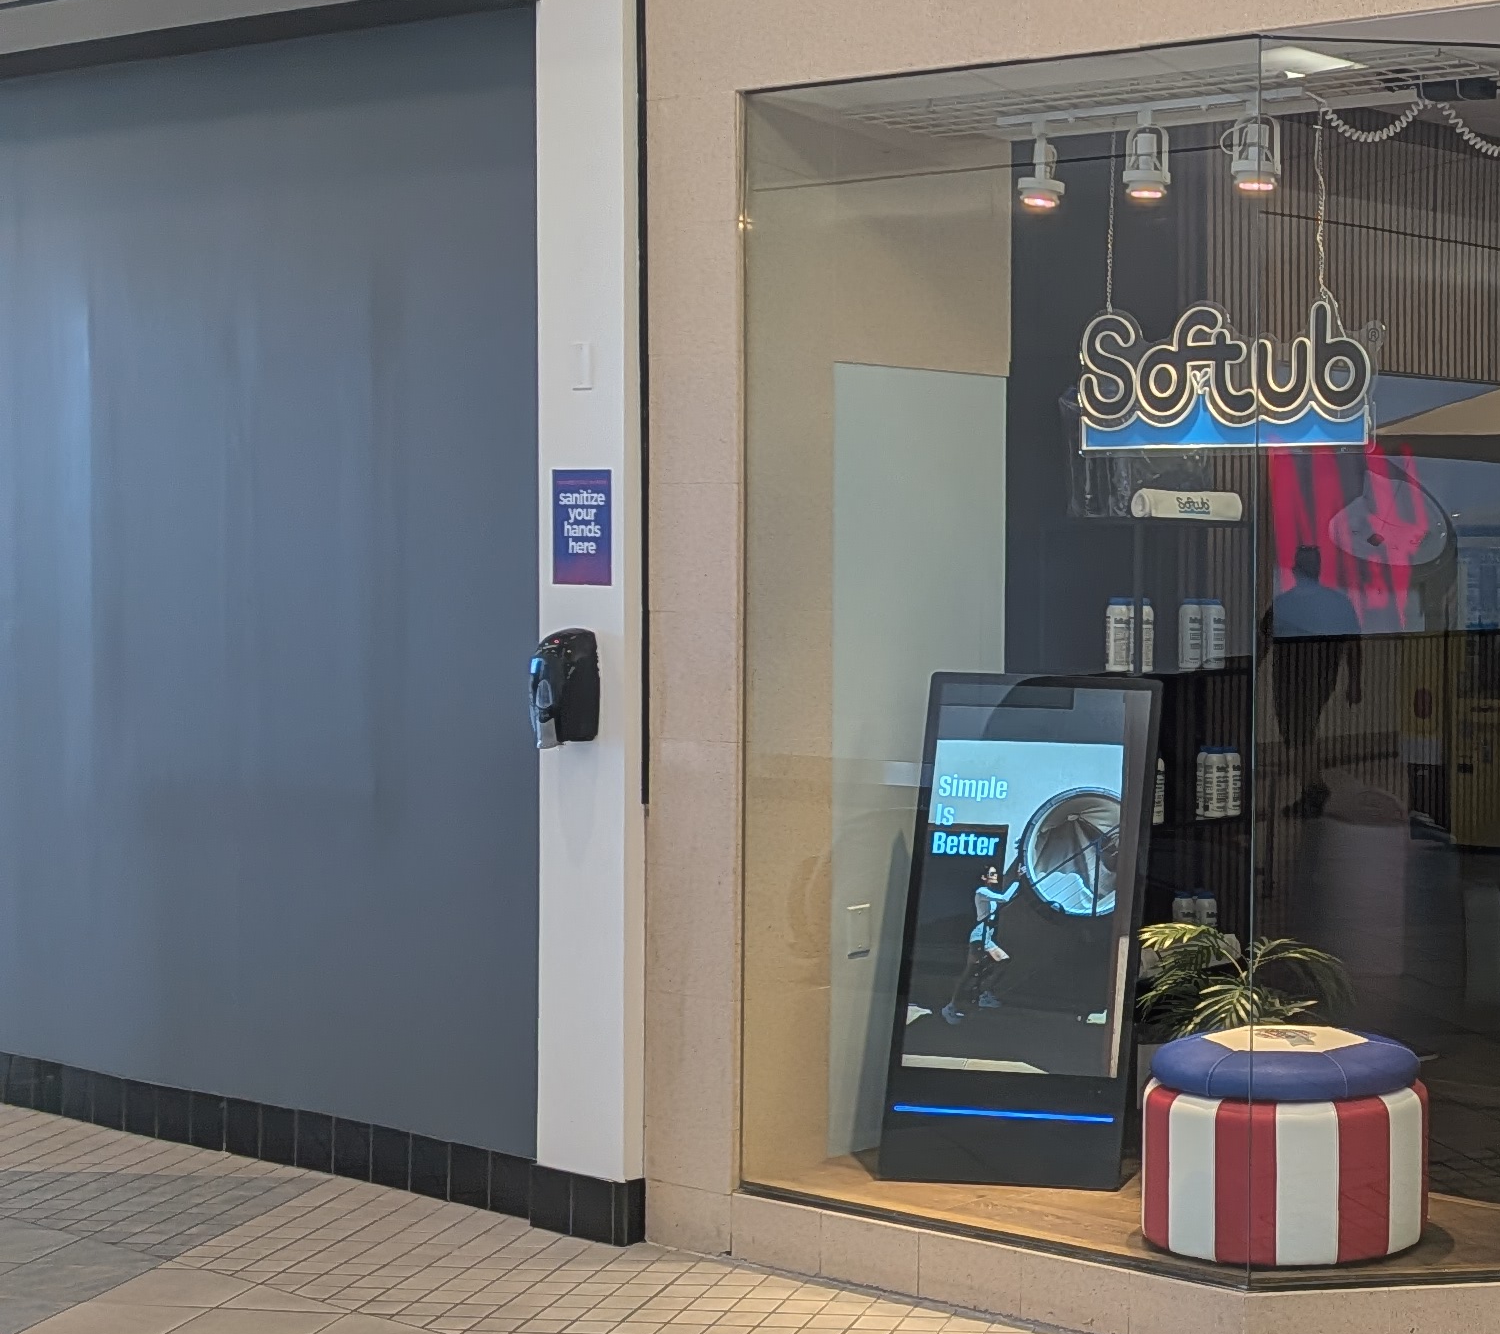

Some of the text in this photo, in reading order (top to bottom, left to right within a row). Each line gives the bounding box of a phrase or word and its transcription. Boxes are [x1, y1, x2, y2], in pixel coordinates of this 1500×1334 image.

[1080, 301, 1370, 418] Softub
[558, 489, 606, 505] sanitize
[568, 508, 597, 523] your
[563, 521, 602, 537] hands
[568, 538, 597, 554] here
[938, 773, 1008, 801] Simple
[934, 803, 955, 825] Is
[931, 831, 1000, 856] Better
